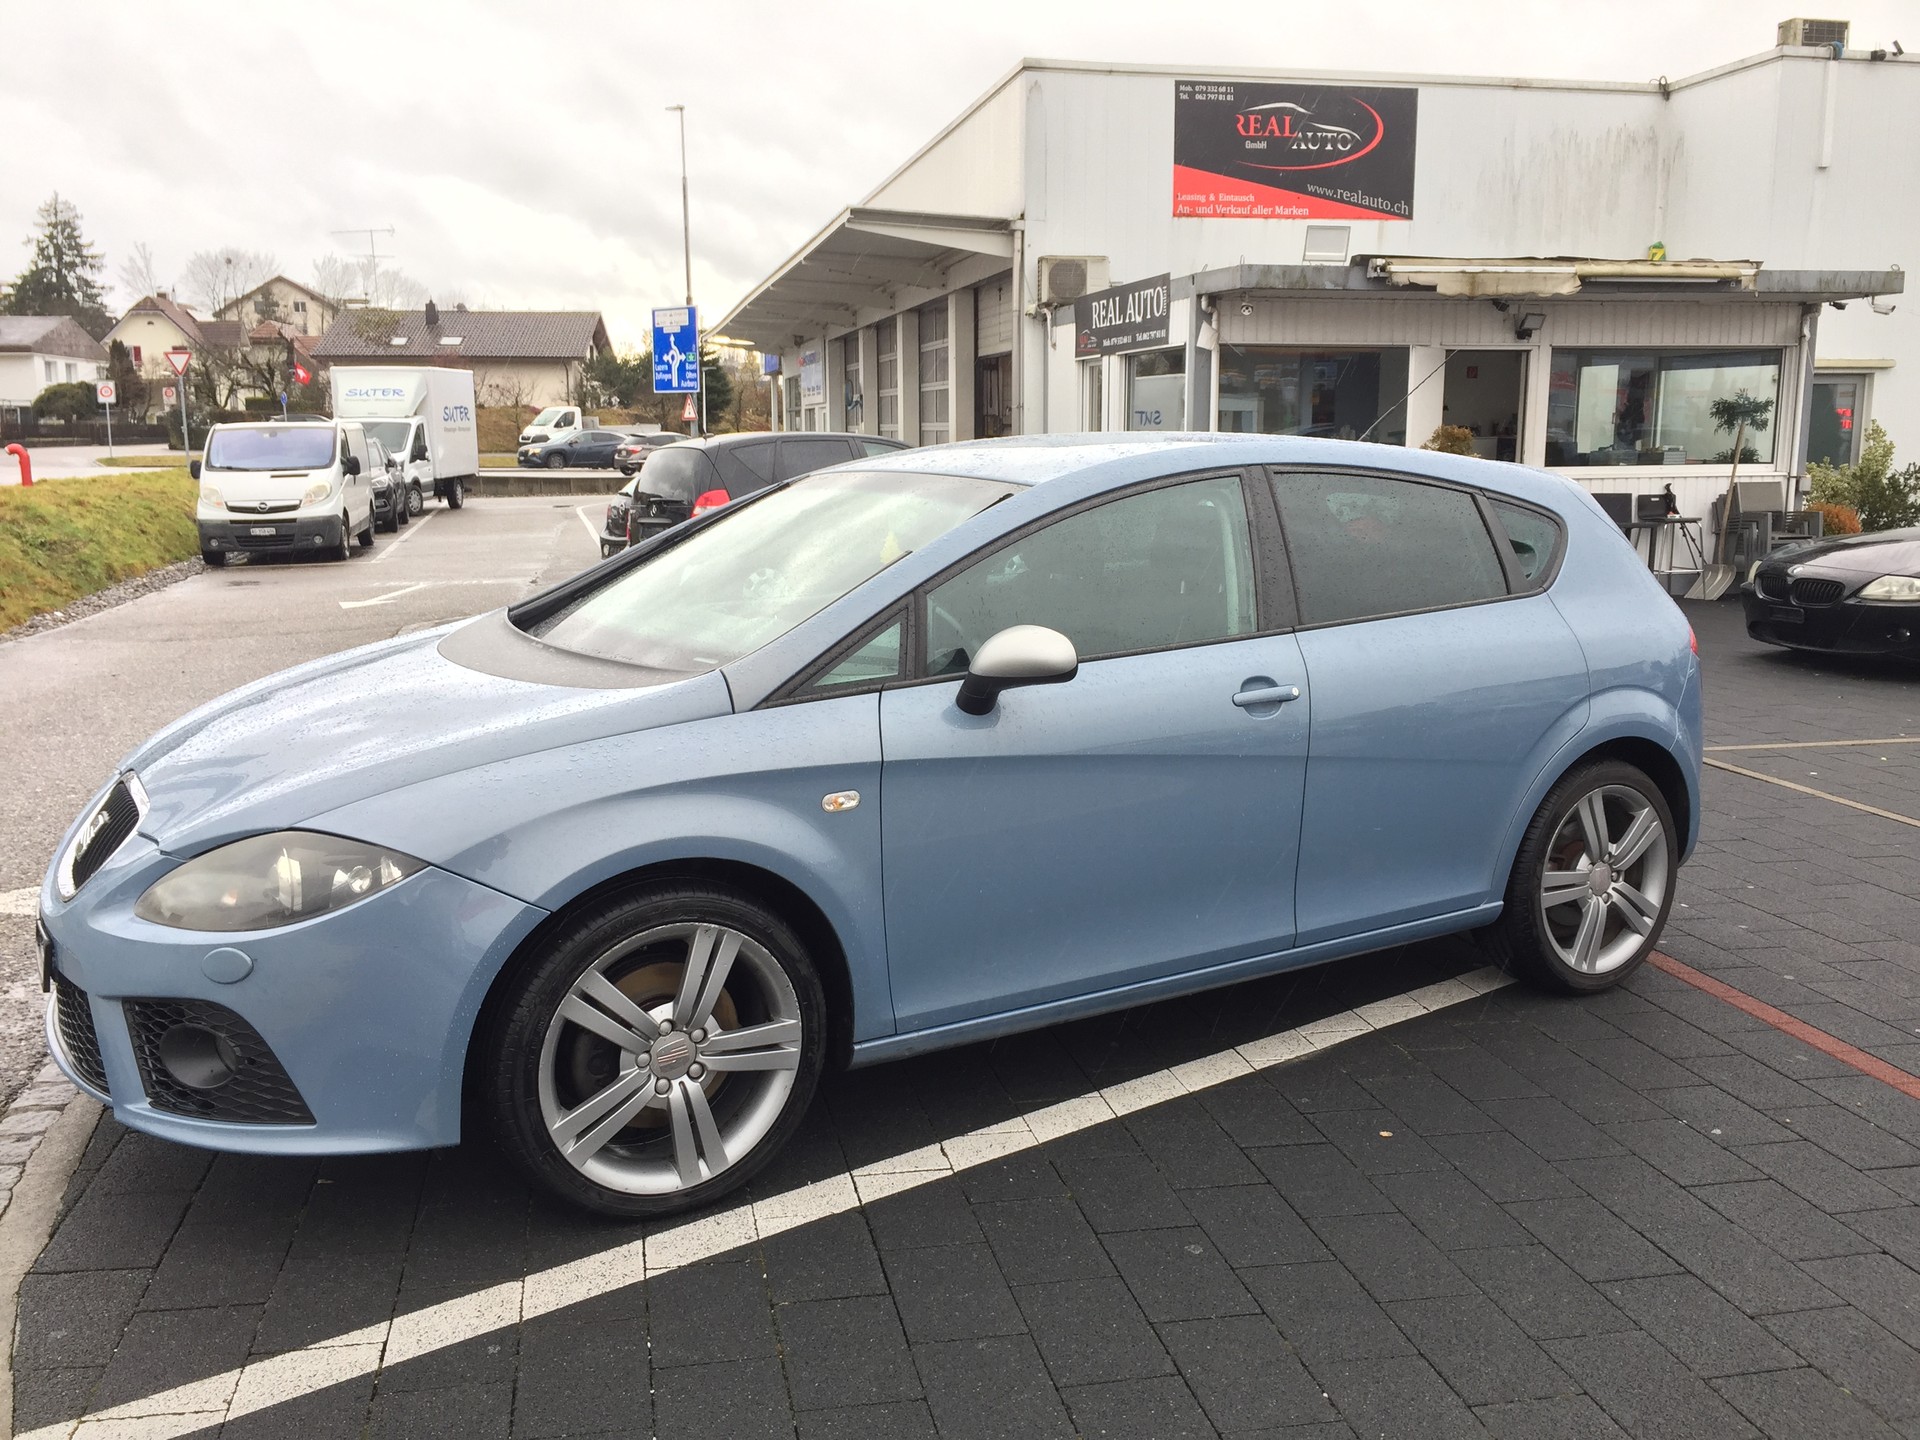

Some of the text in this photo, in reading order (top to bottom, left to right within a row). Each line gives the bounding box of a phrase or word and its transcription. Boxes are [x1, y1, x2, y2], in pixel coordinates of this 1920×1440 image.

[1236, 114, 1299, 137] REAL
[1245, 140, 1267, 149] GmbH
[1292, 132, 1354, 151] AUTO
[1177, 193, 1206, 202] Leasing
[1219, 193, 1254, 202] Eintausch
[1307, 183, 1409, 216] www.realauto.ch
[1177, 204, 1309, 215] An- und Verkauf aller Marken
[1092, 286, 1163, 329] REAL AUTO
[686, 371, 696, 379] Olten
[345, 388, 405, 397] SUTER
[442, 406, 470, 423] SUTER
